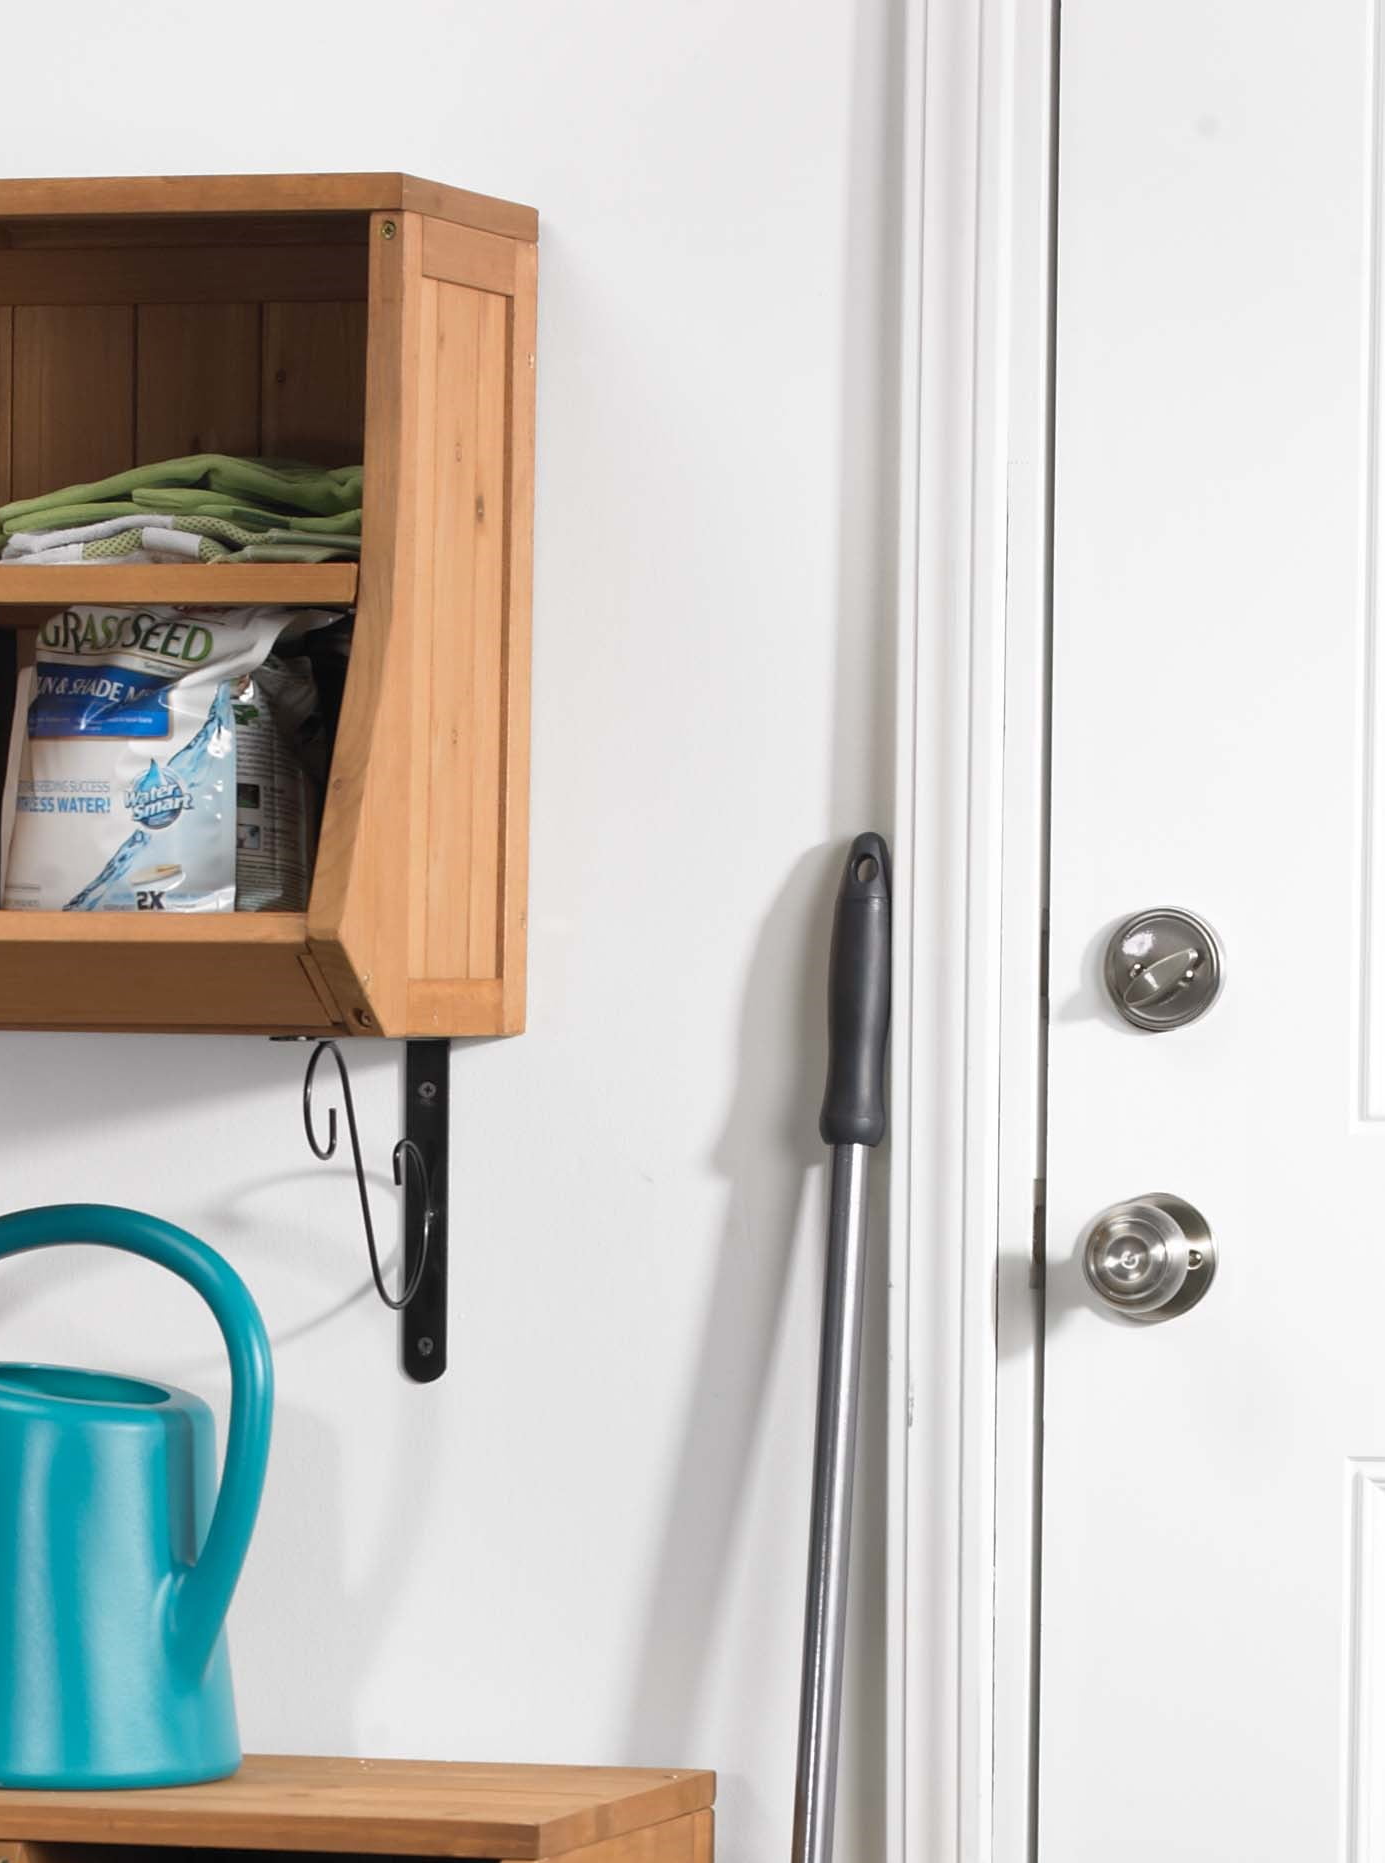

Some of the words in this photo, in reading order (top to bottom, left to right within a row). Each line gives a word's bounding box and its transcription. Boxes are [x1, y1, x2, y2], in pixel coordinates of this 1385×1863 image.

[68, 677, 124, 702] SHADE
[56, 796, 111, 813] WATER!
[124, 784, 180, 808] Water
[132, 794, 194, 821] Smart
[136, 890, 165, 910] 2X
